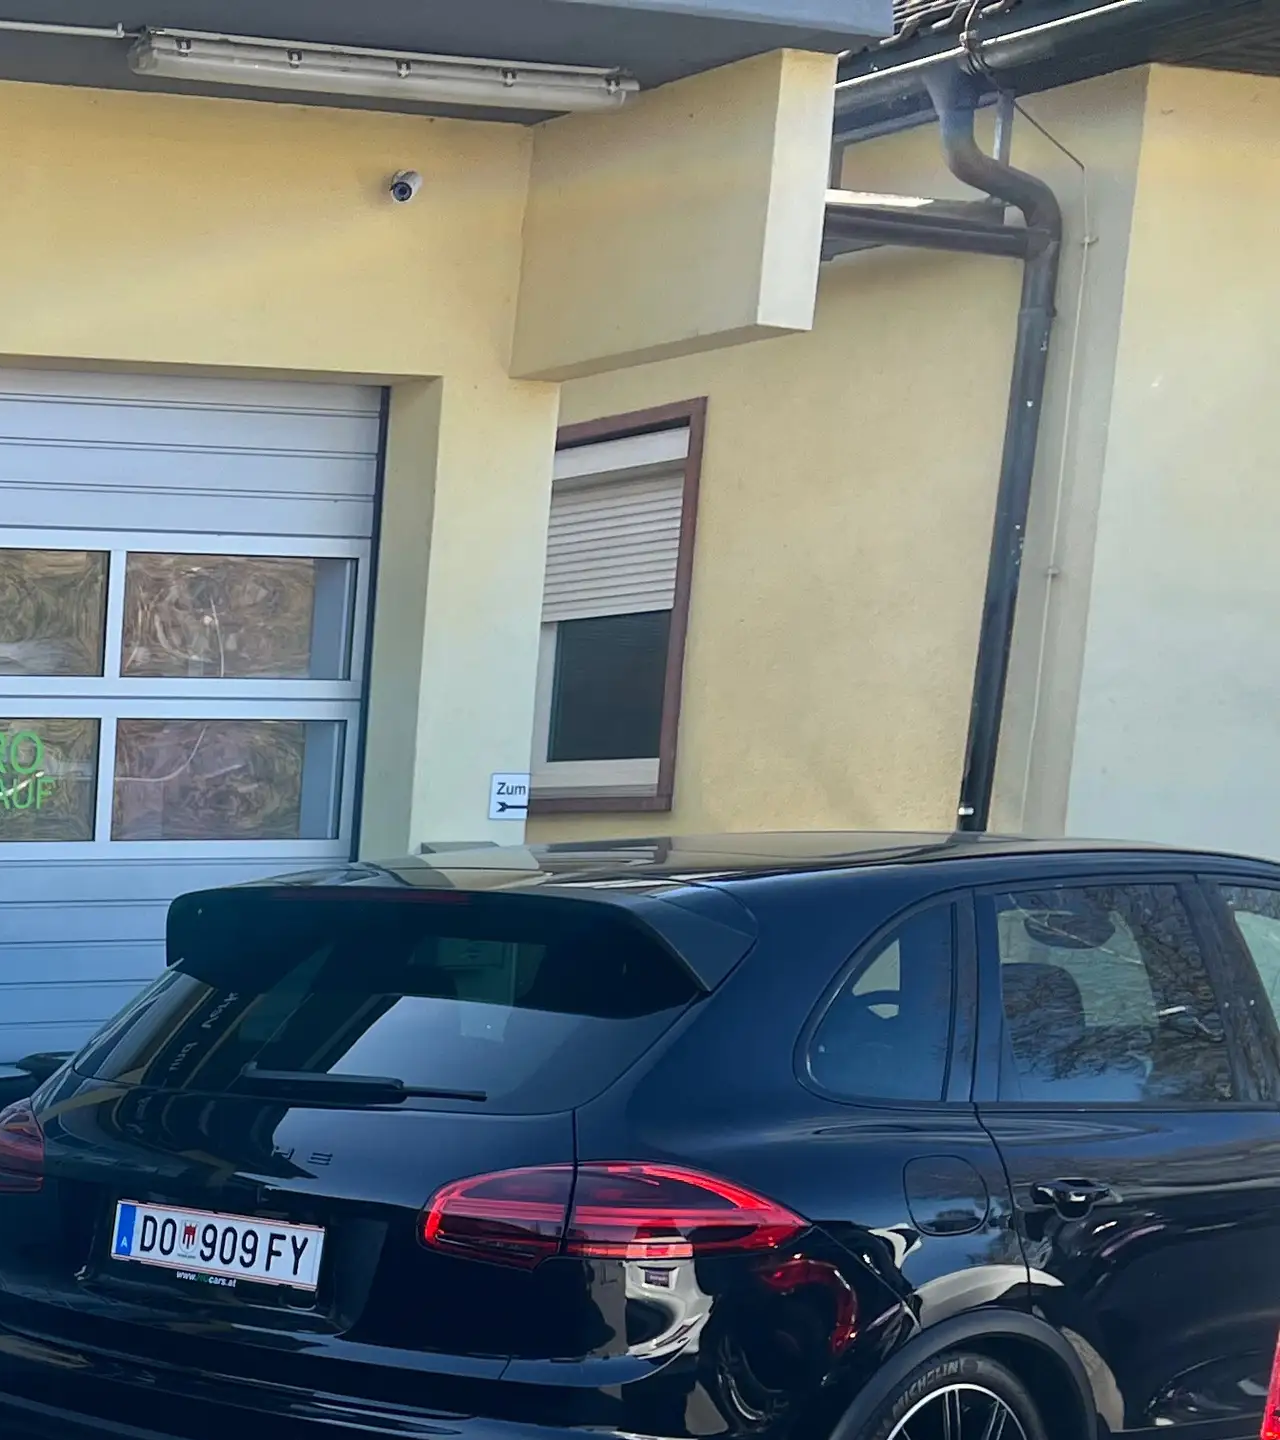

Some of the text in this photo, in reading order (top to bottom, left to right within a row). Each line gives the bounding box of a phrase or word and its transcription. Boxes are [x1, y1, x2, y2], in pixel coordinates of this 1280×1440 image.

[496, 782, 527, 796] Zum
[120, 1235, 129, 1248] A
[140, 1215, 309, 1275] DO 909 FY
